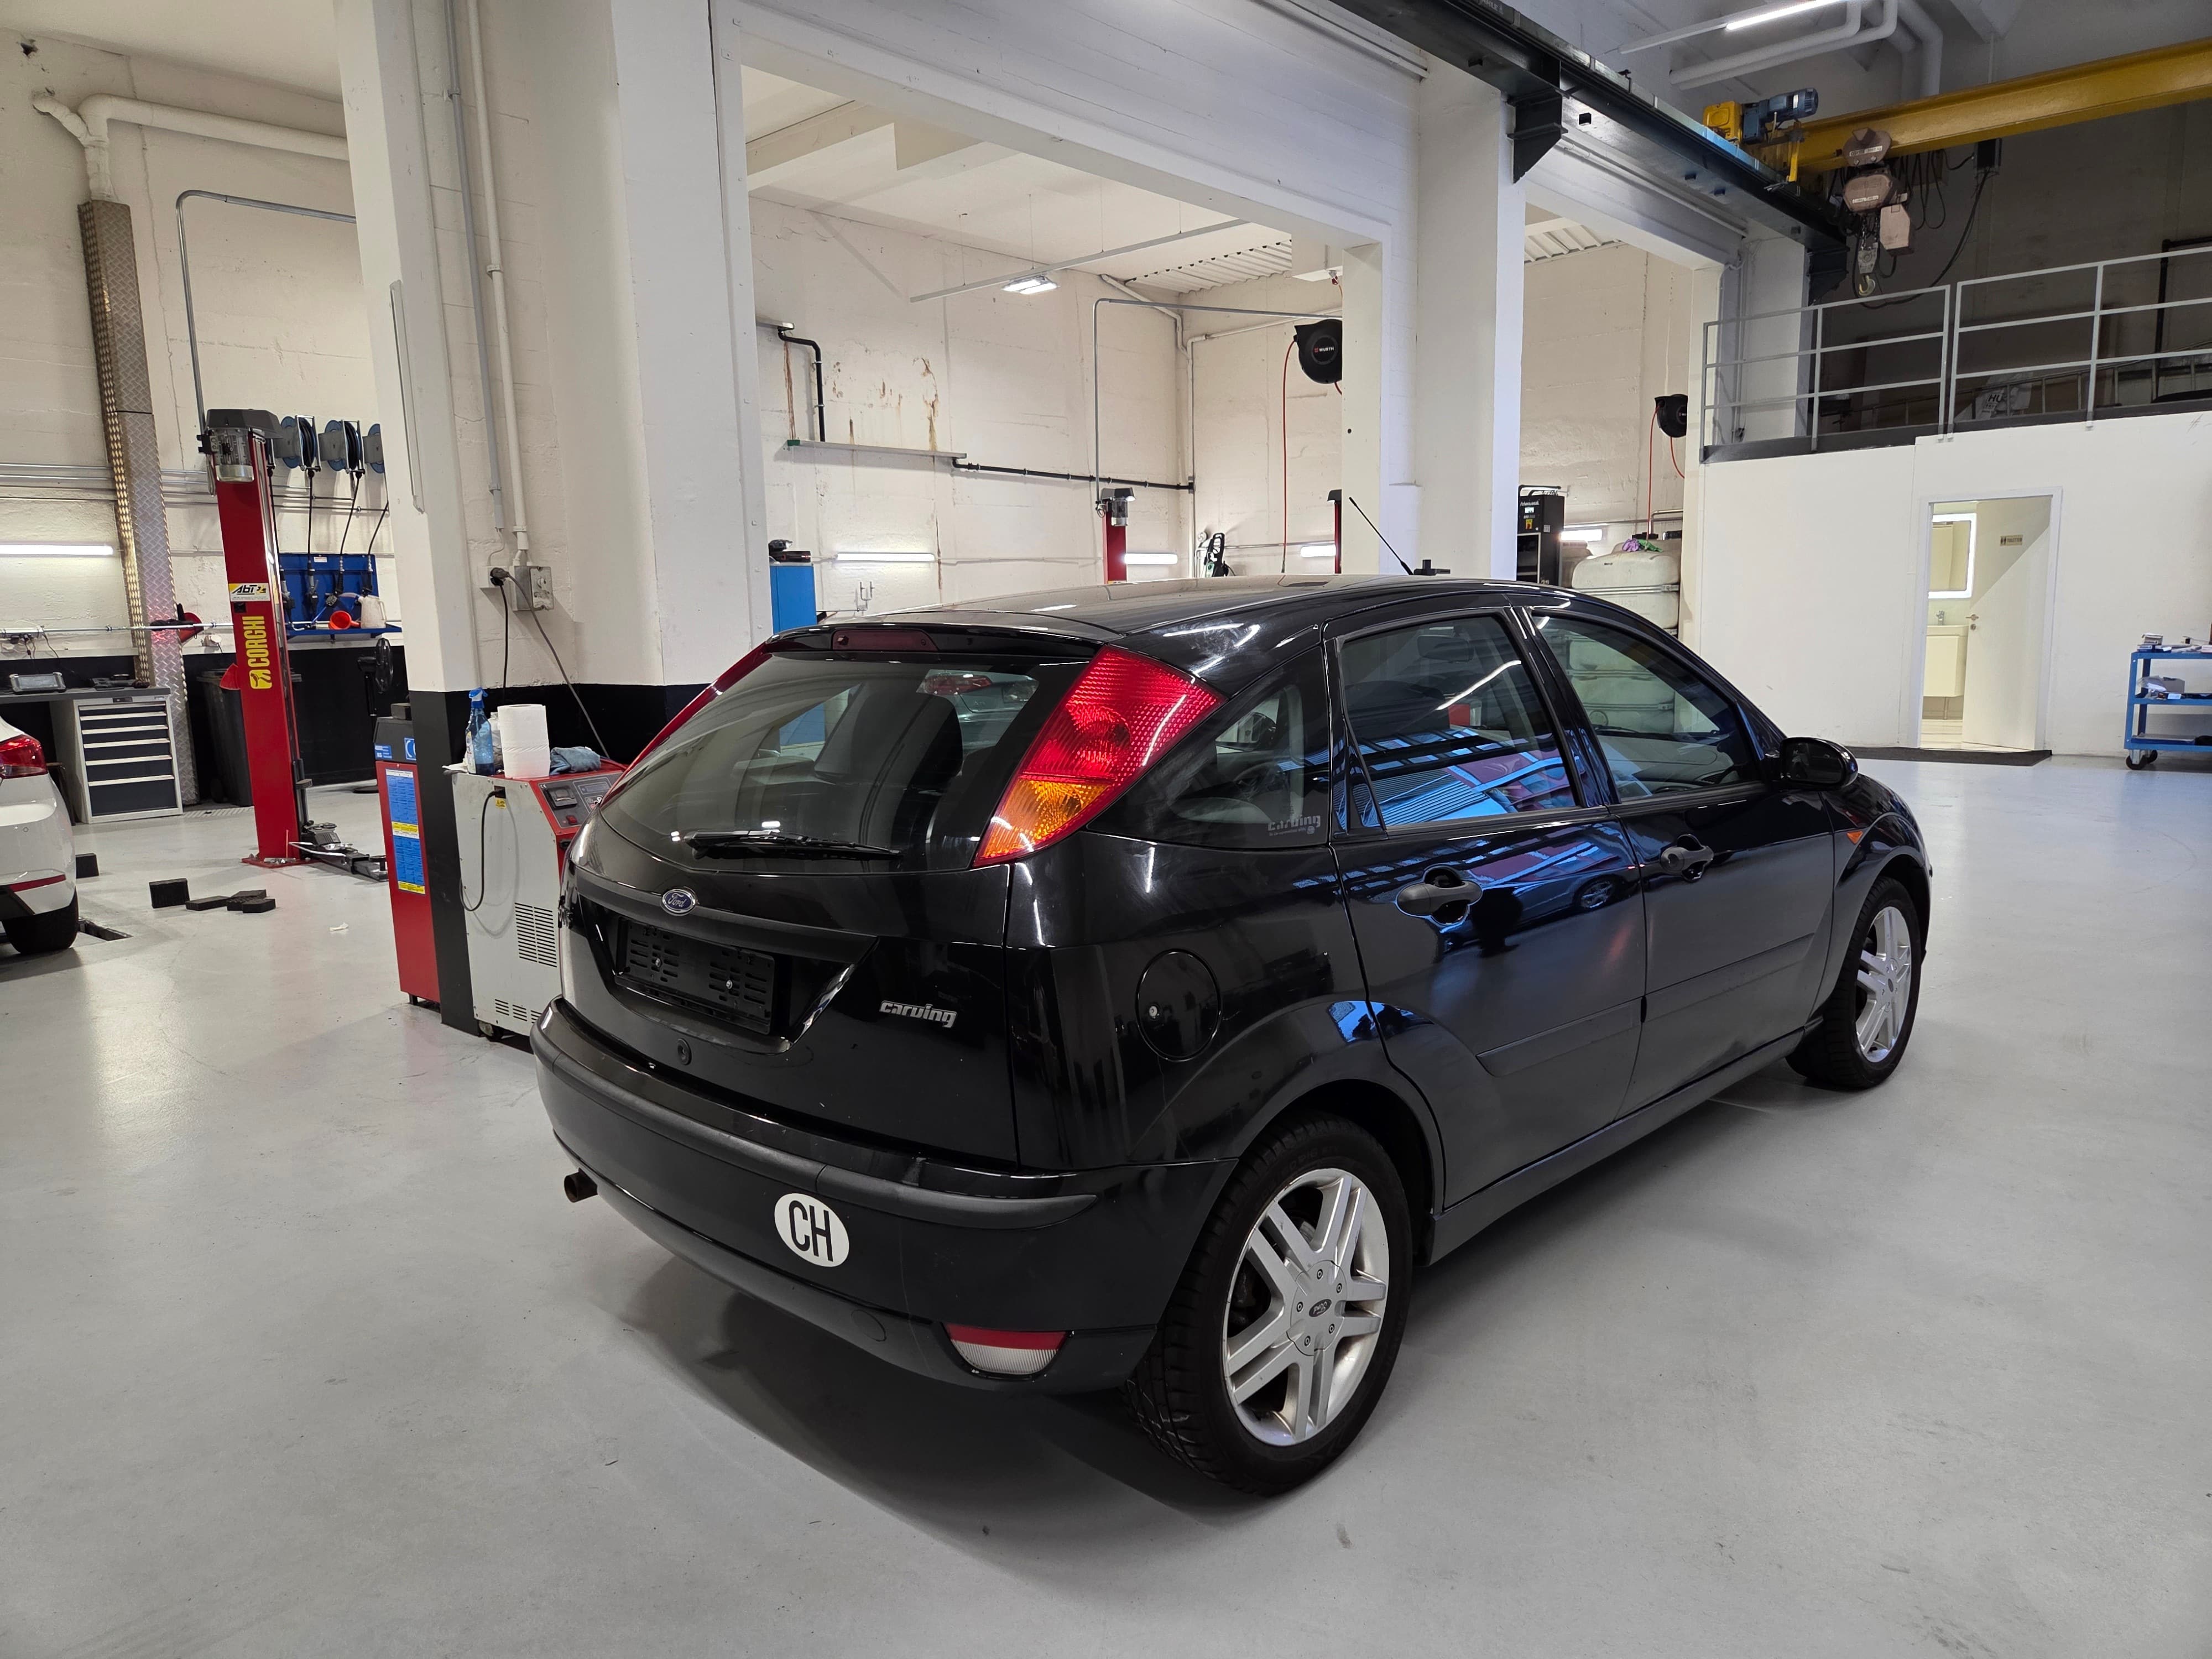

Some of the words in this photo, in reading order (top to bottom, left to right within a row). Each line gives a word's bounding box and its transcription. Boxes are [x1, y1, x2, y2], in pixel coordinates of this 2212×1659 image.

[242, 616, 269, 667] CORGHI
[879, 1000, 957, 1027] carving
[789, 1200, 833, 1262] CH
